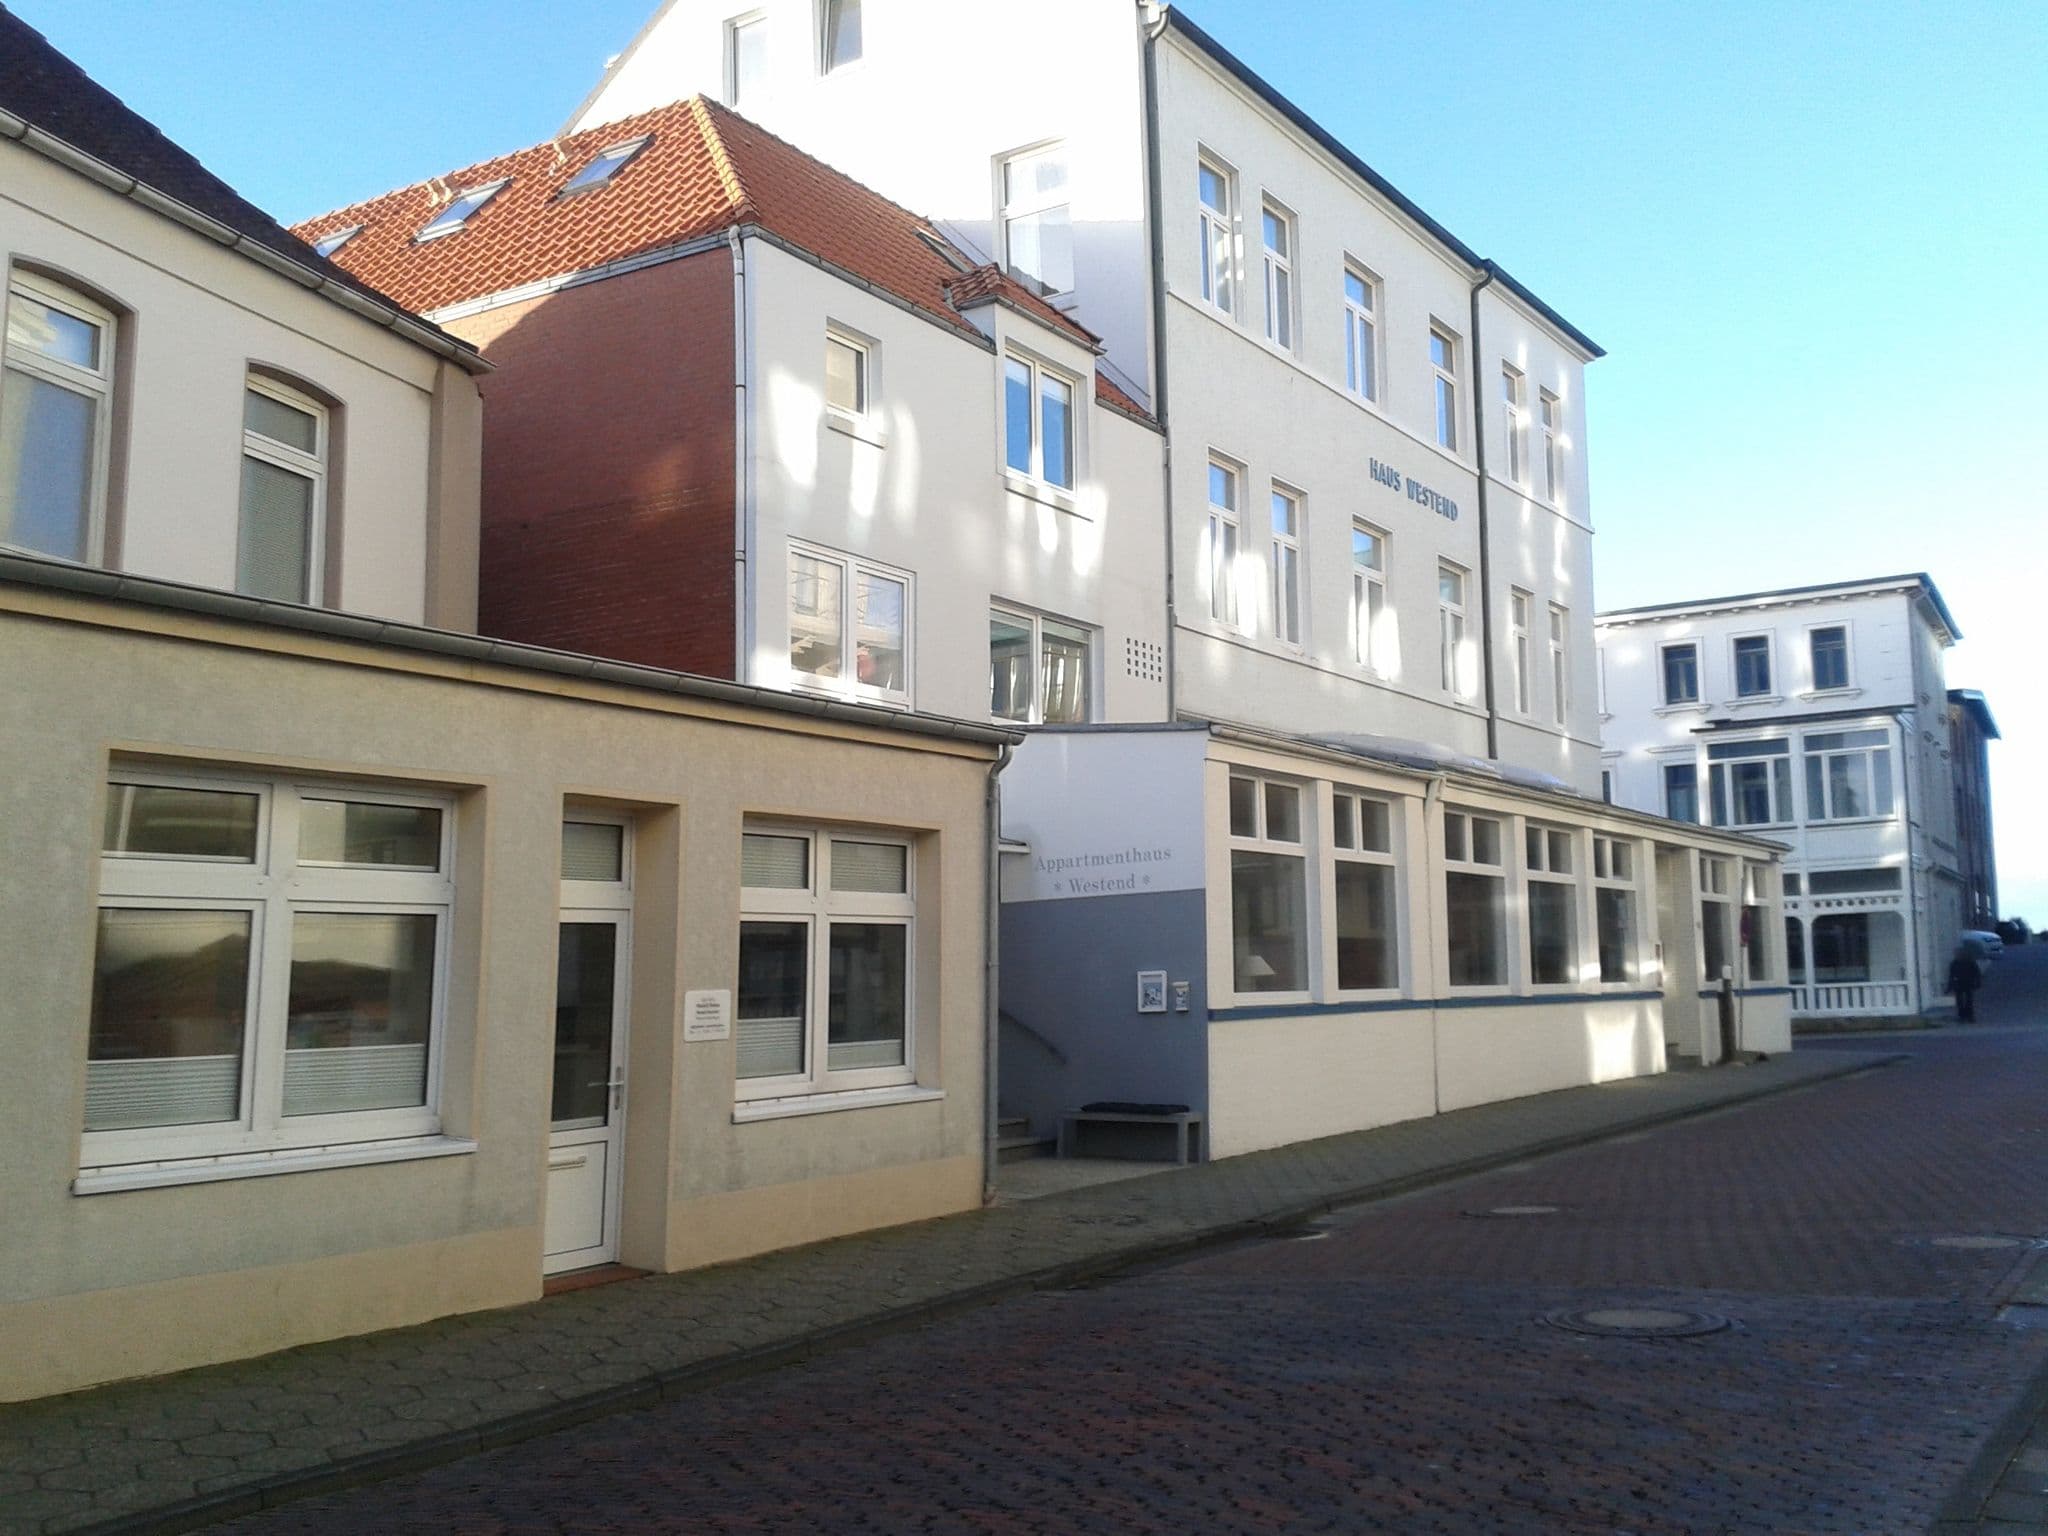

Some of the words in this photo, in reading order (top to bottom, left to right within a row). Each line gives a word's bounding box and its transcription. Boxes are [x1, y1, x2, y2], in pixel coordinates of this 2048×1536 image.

[1369, 457, 1400, 491] HAUS
[1406, 477, 1458, 521] WESTEND
[1036, 848, 1172, 872] Appartmenthaus
[1069, 873, 1136, 893] Westend
